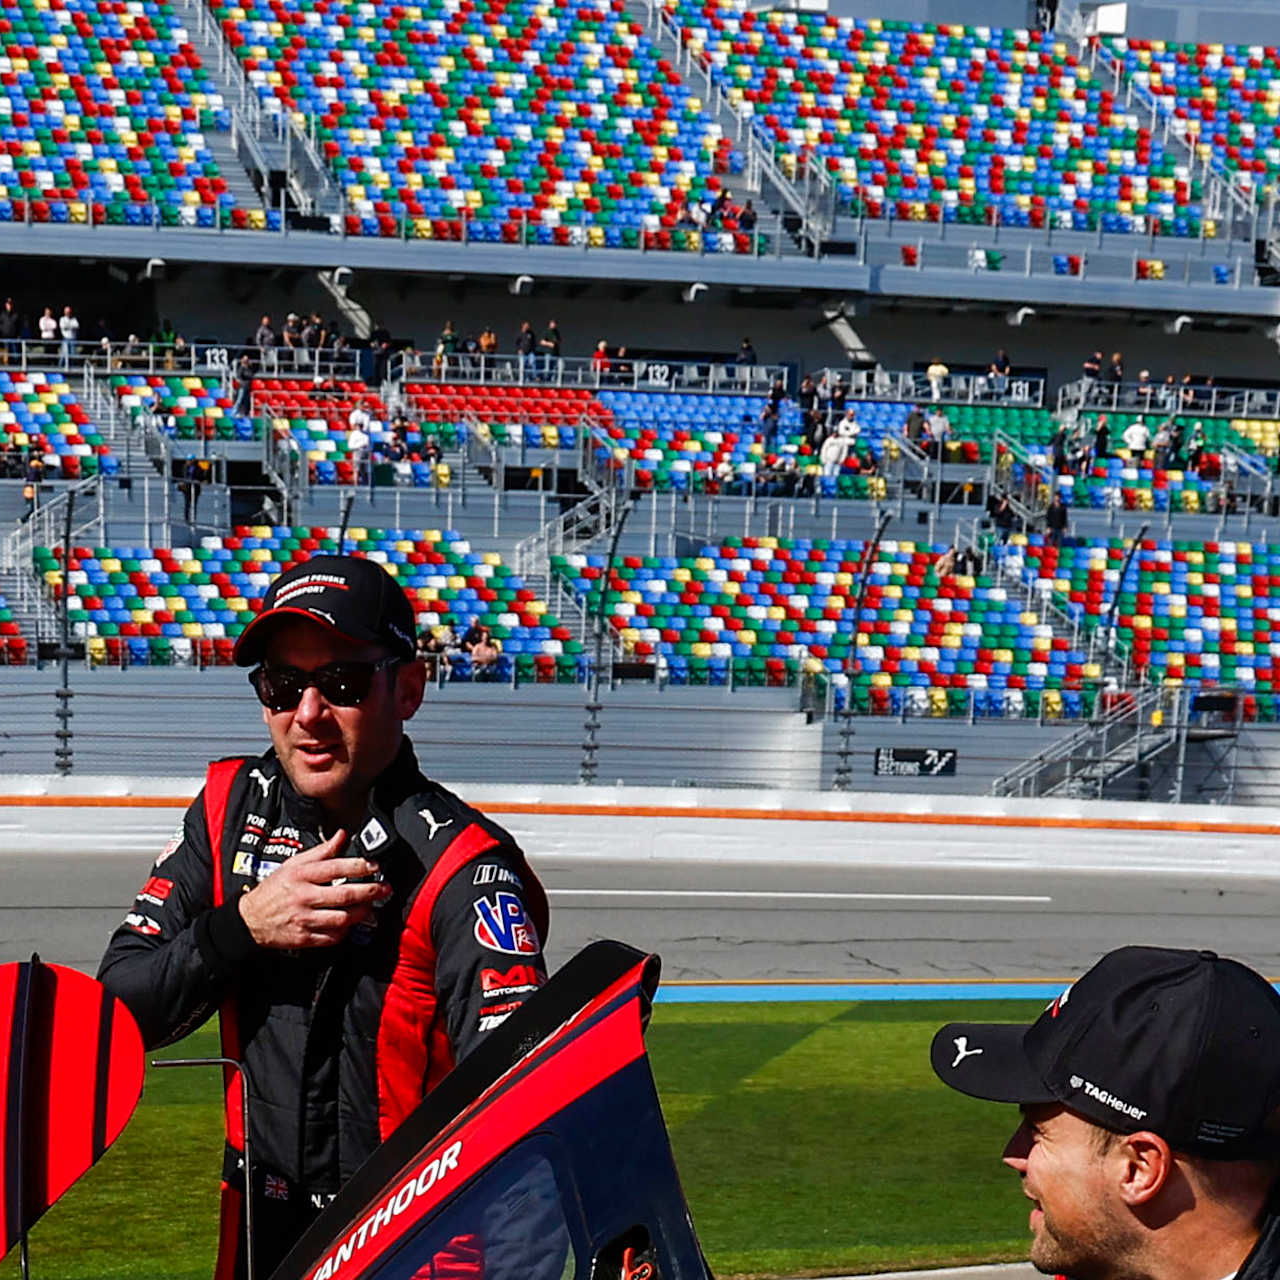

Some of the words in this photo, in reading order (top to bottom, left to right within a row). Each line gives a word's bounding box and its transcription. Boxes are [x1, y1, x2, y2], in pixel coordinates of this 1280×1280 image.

[204, 348, 229, 371] 133
[647, 364, 670, 387] 132
[1010, 380, 1030, 402] 131
[878, 748, 896, 761] ALL
[878, 760, 922, 776] SECTIONS
